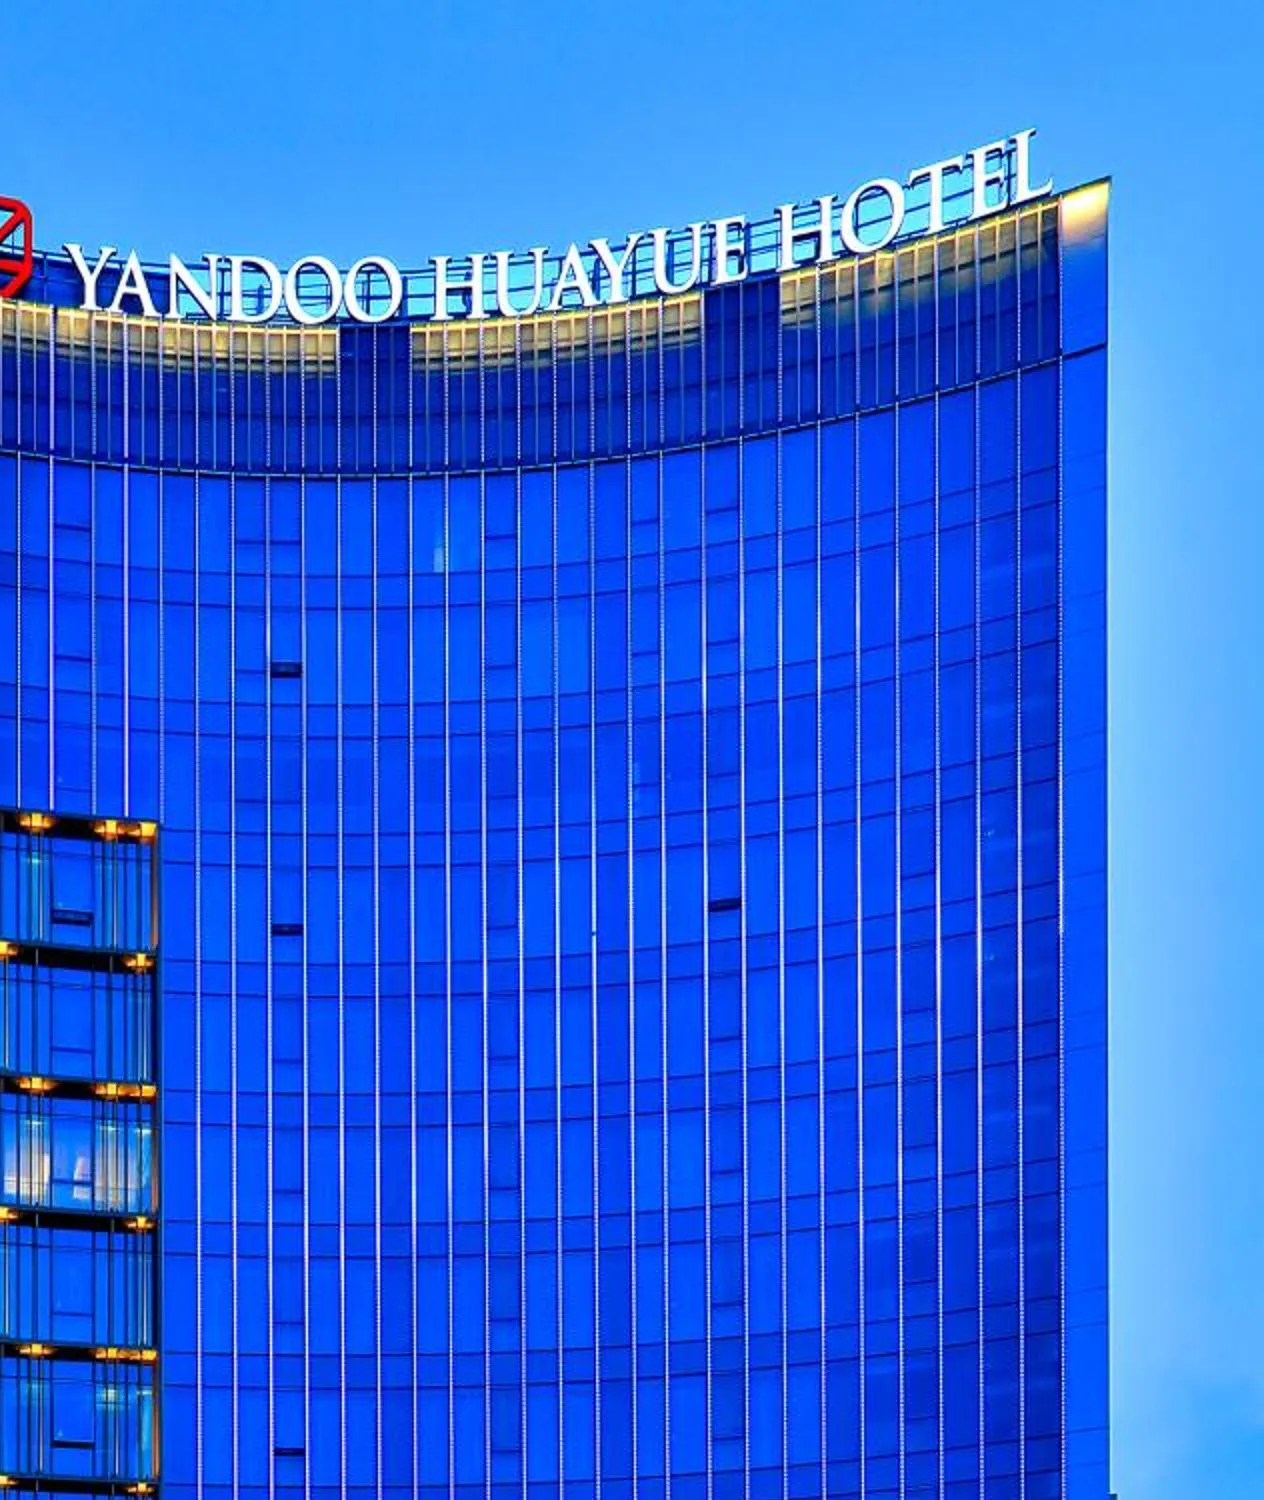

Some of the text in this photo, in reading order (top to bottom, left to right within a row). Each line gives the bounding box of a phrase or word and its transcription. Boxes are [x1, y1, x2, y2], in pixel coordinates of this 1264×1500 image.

[62, 129, 1054, 324] YANDOO HUAYUE HOTEL
